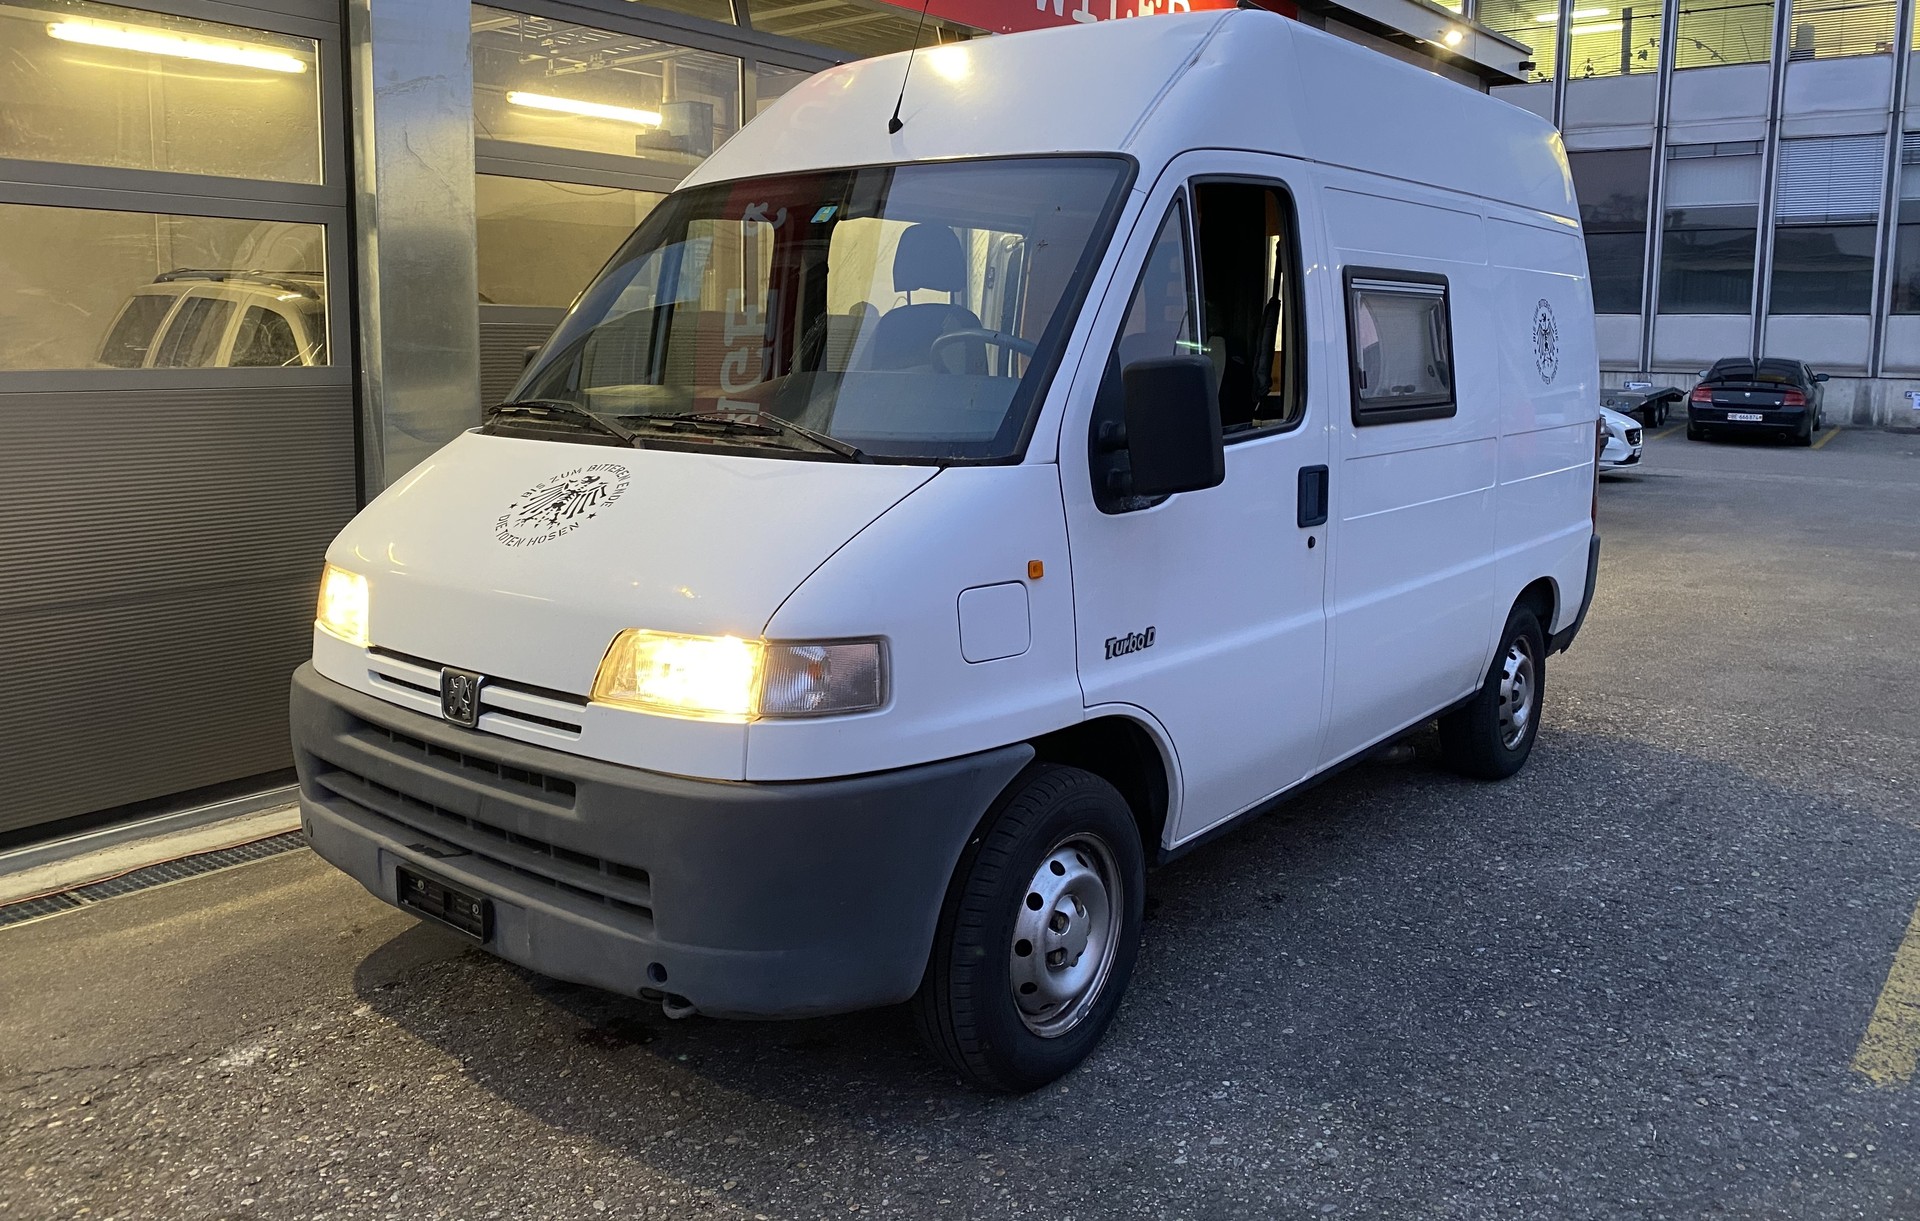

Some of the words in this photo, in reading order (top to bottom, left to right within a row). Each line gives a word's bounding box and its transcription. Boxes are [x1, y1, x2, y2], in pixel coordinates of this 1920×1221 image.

[550, 467, 583, 484] ZUM
[586, 463, 631, 482] BITTEREN
[521, 483, 545, 498] BIS
[600, 481, 630, 508] ENDE
[495, 514, 511, 531] DIE
[496, 529, 526, 548] TOTEN
[526, 521, 580, 547] HOSEN
